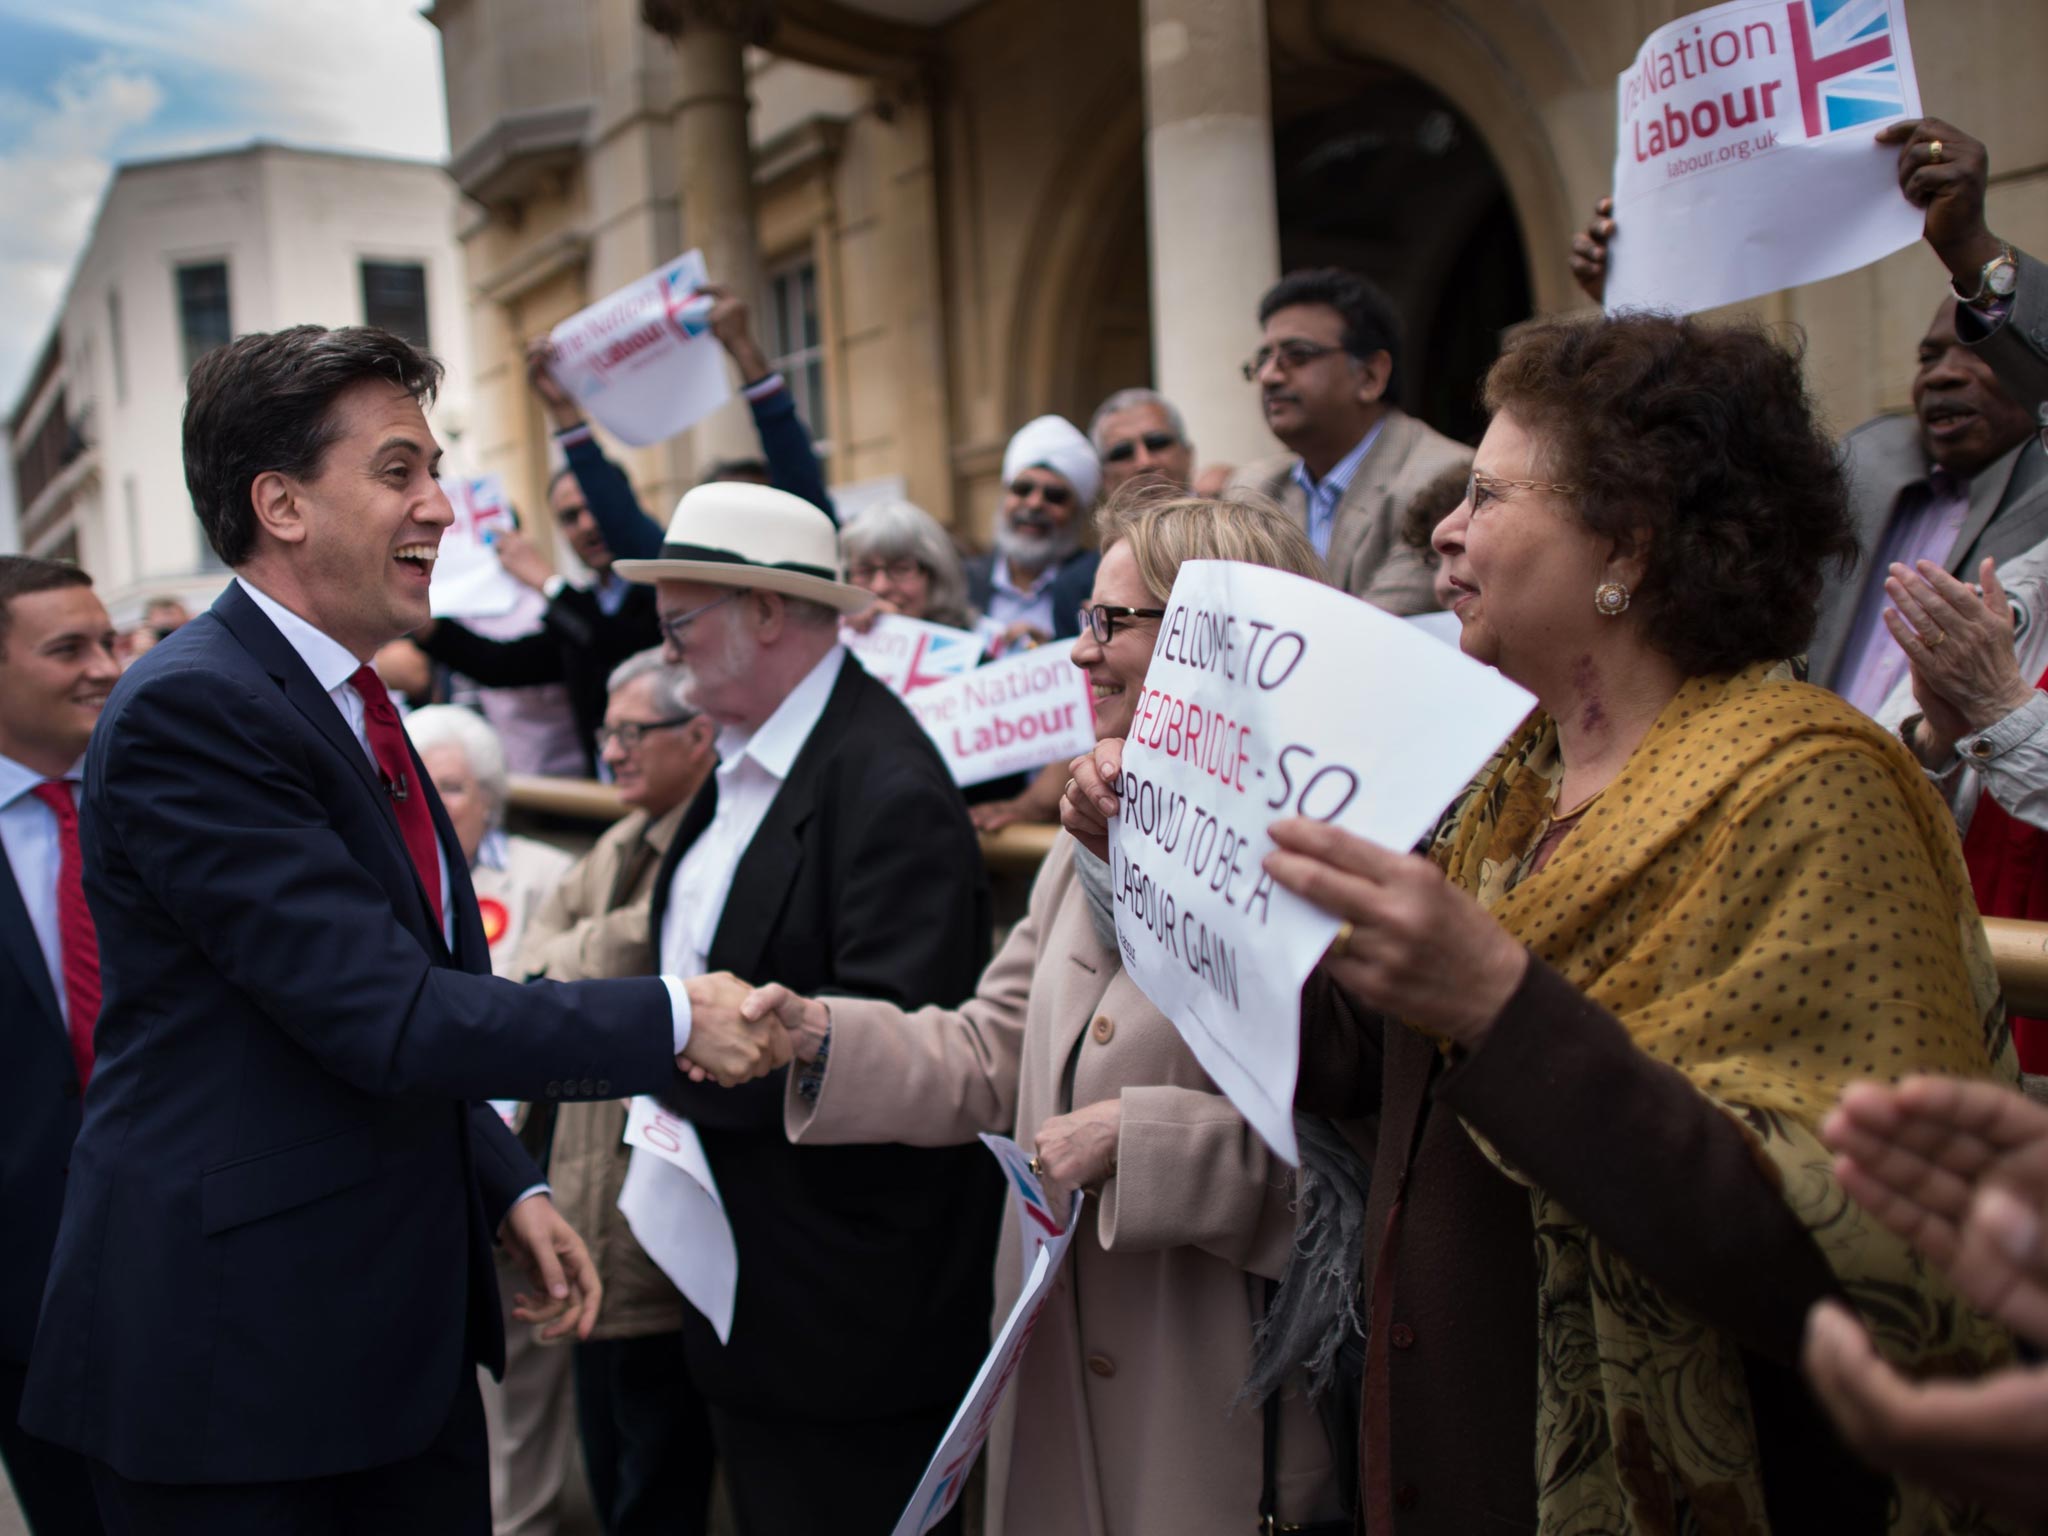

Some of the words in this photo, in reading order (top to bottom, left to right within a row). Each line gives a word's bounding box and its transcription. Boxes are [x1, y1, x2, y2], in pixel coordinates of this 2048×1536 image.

[1642, 21, 1777, 101] Nation
[1634, 79, 1783, 163] Labour
[1667, 129, 1779, 179] labour.org.uk
[963, 658, 1075, 713] Nation
[1243, 619, 1307, 691] TO
[952, 702, 1078, 759] Labour
[1113, 767, 1187, 854] PROUD
[1184, 805, 1218, 877] TO
[1210, 826, 1249, 906] BE
[1245, 868, 1276, 926] A
[1113, 846, 1179, 959] LABOUR
[1183, 910, 1240, 1011] GAIN
